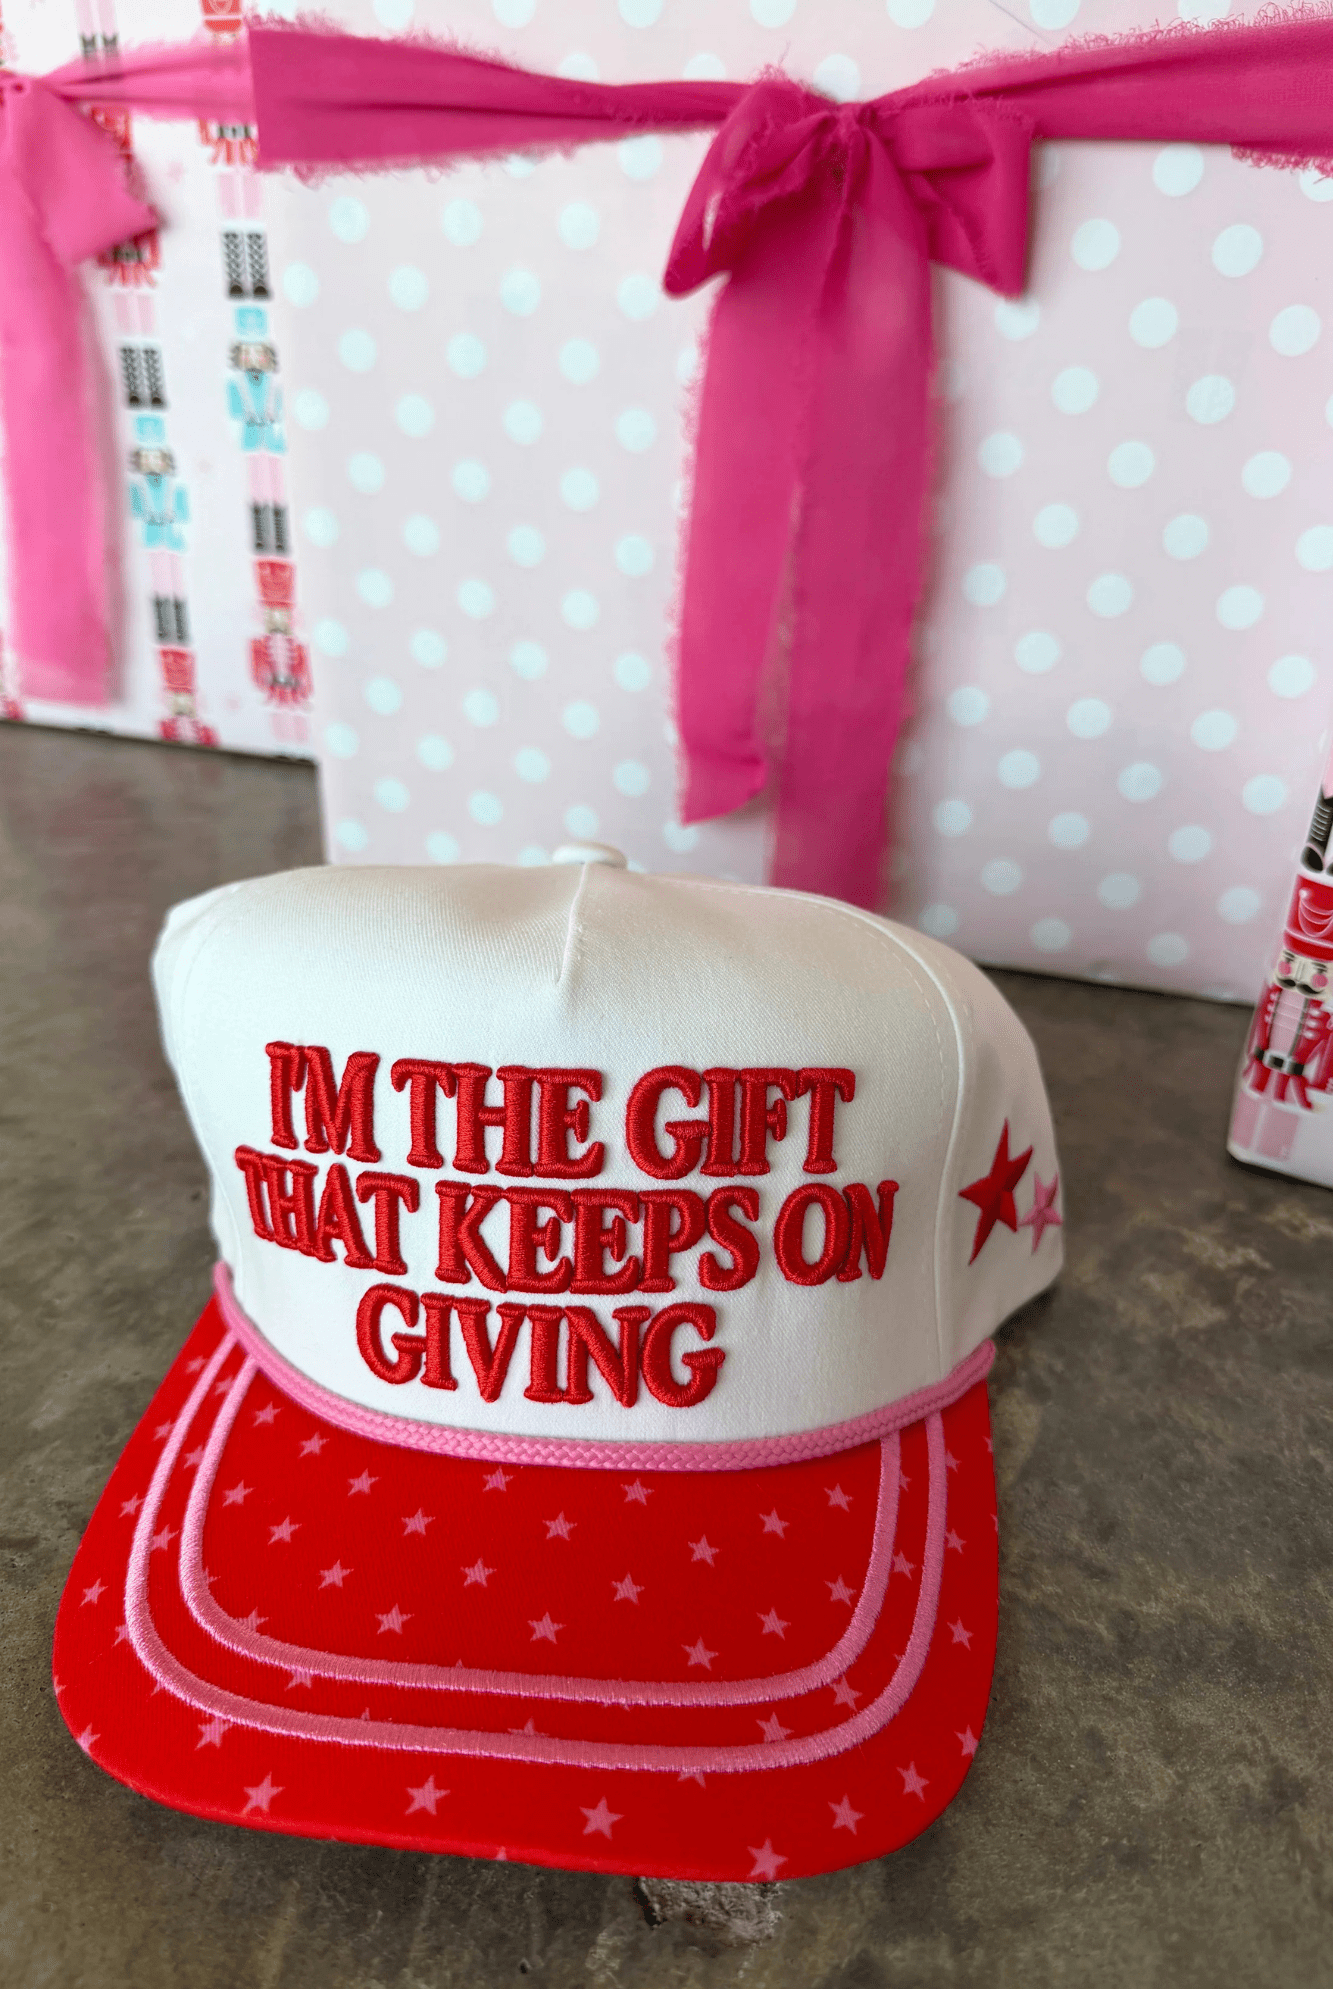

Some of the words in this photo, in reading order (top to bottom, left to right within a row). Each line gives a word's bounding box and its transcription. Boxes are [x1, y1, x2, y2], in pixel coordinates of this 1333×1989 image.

[391, 1057, 605, 1179] THE
[625, 1064, 855, 1180] GIFT
[234, 1144, 420, 1275] THAT
[434, 1180, 760, 1294] KEEPS
[773, 1179, 899, 1286] ON
[355, 1282, 725, 1408] GIVING
